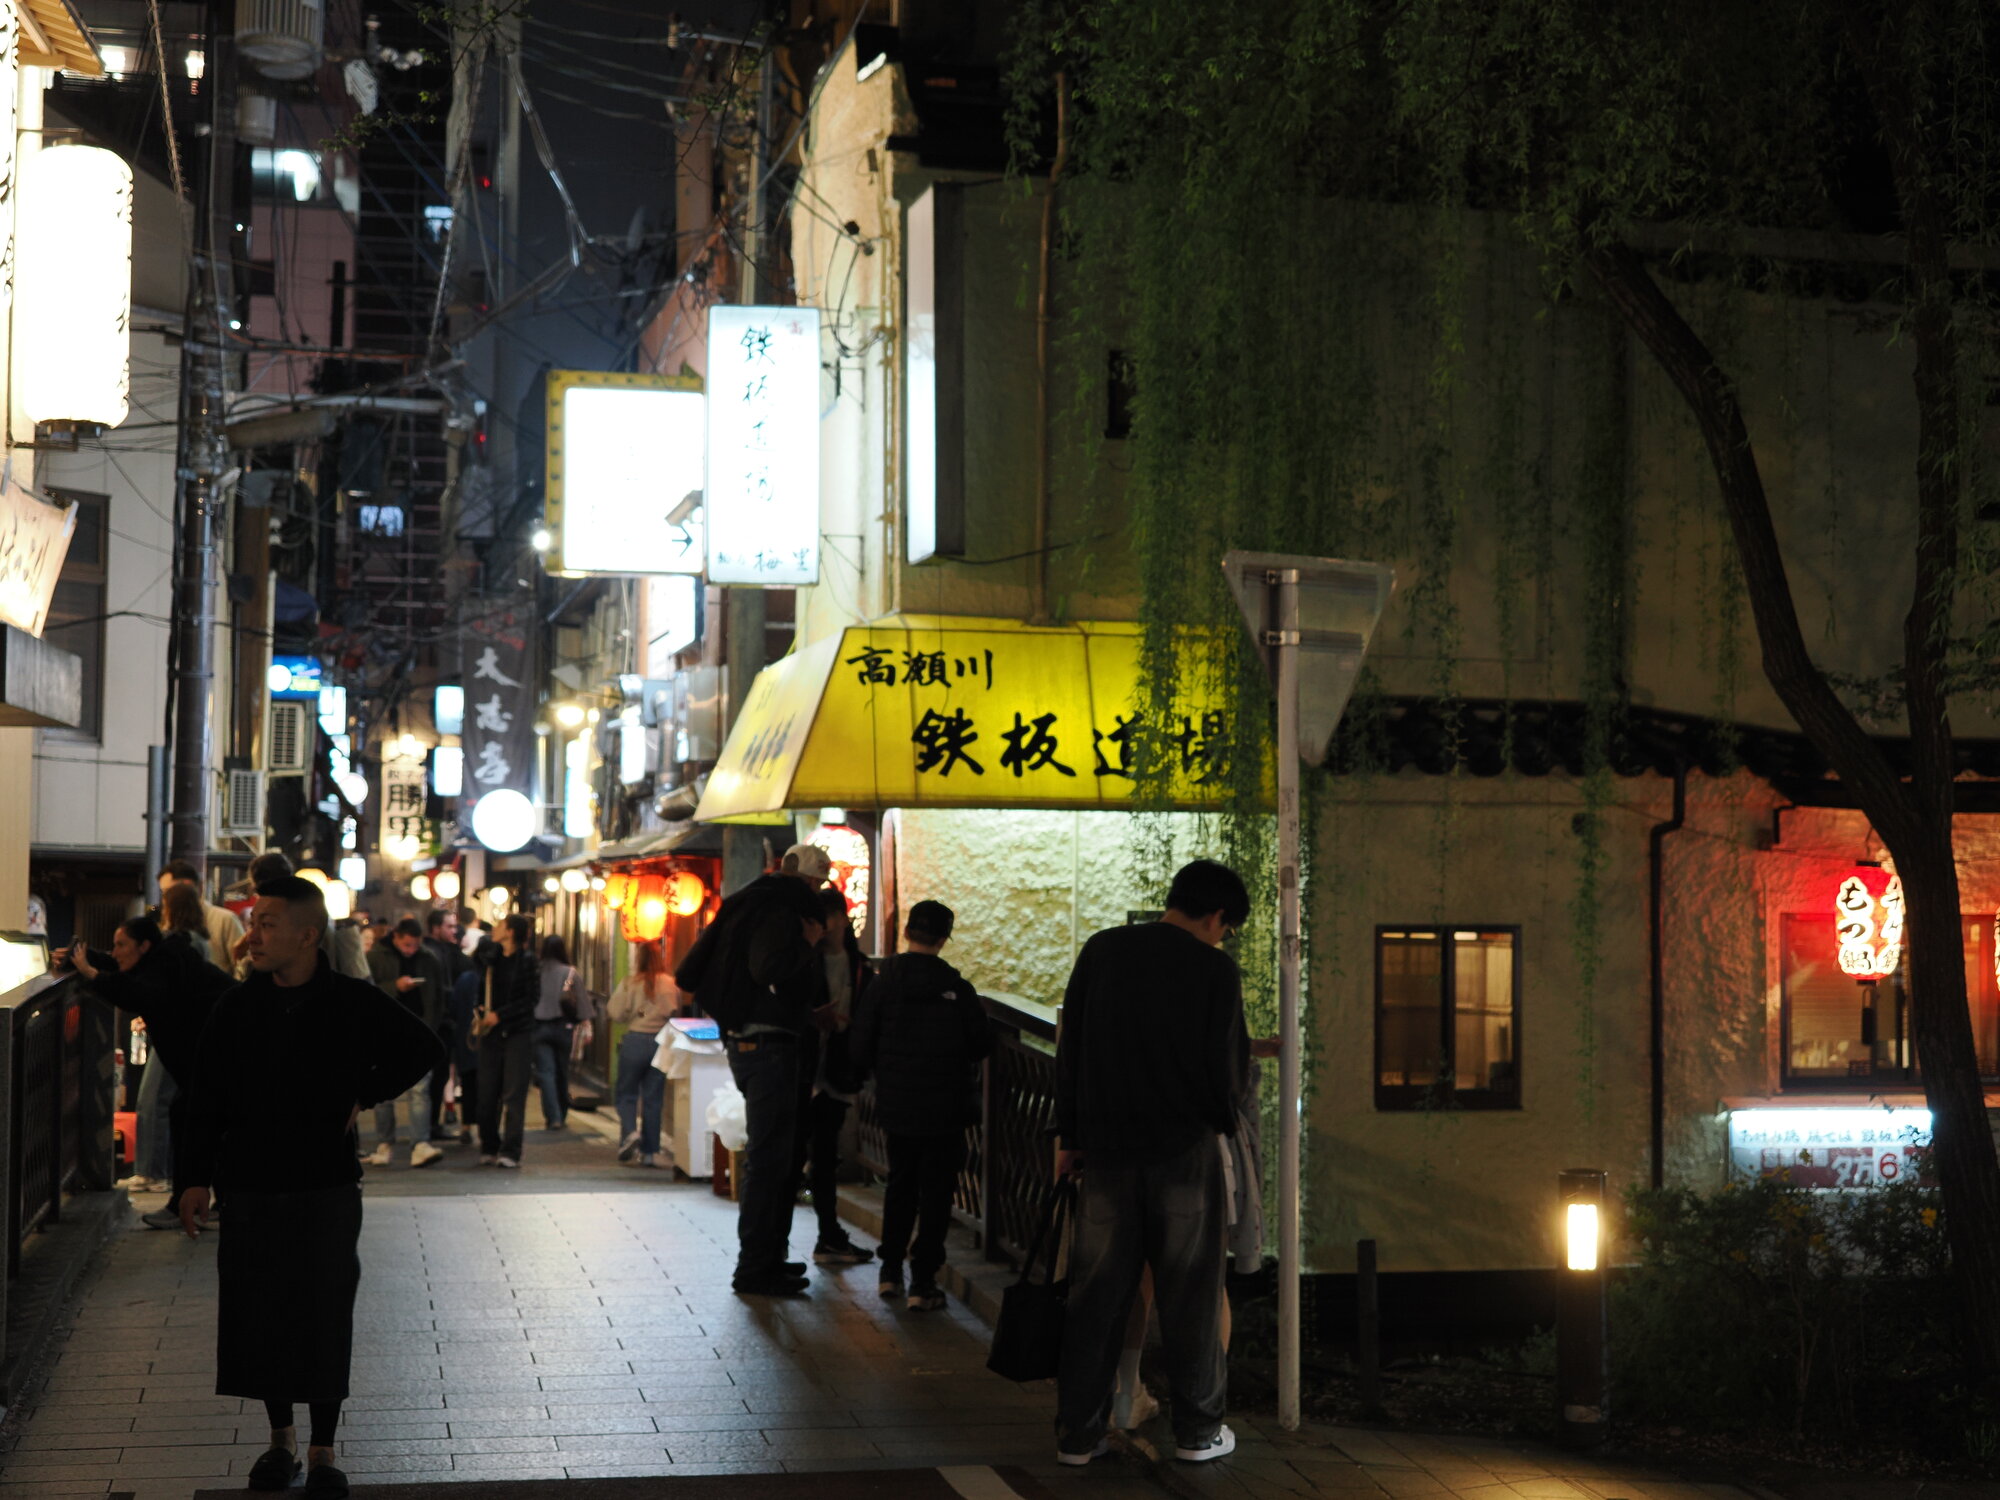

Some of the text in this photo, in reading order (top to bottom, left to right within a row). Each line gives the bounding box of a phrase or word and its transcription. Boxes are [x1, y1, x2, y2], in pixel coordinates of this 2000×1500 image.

[846, 646, 993, 690] 高瀬川
[1839, 881, 1872, 970] もつ鍋
